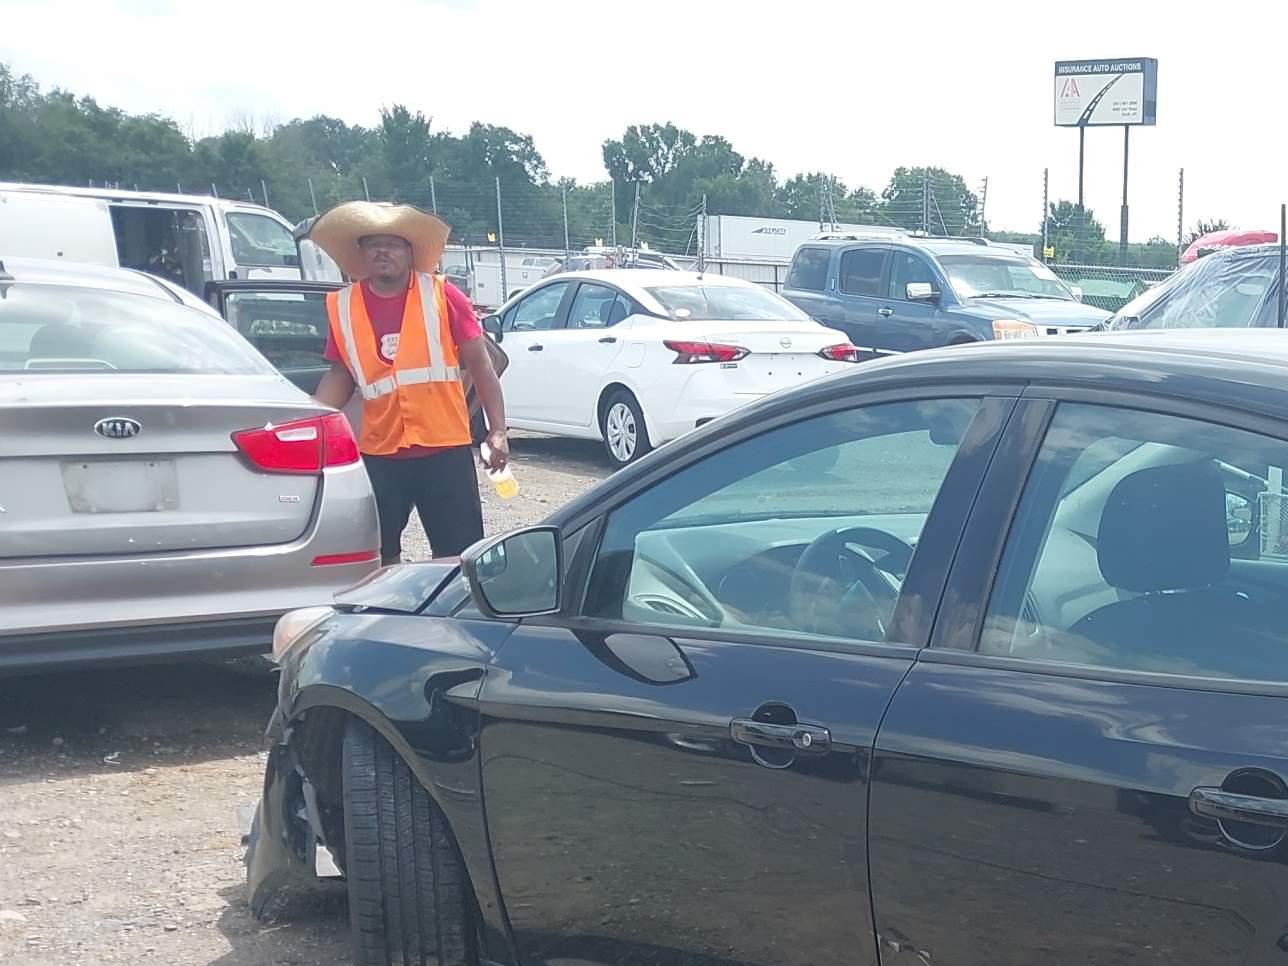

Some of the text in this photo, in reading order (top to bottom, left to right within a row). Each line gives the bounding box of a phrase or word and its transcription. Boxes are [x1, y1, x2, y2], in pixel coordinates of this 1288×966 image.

[1058, 63, 1141, 73] INSURANCE AUTO AUCTIONS
[102, 422, 136, 436] KIA
